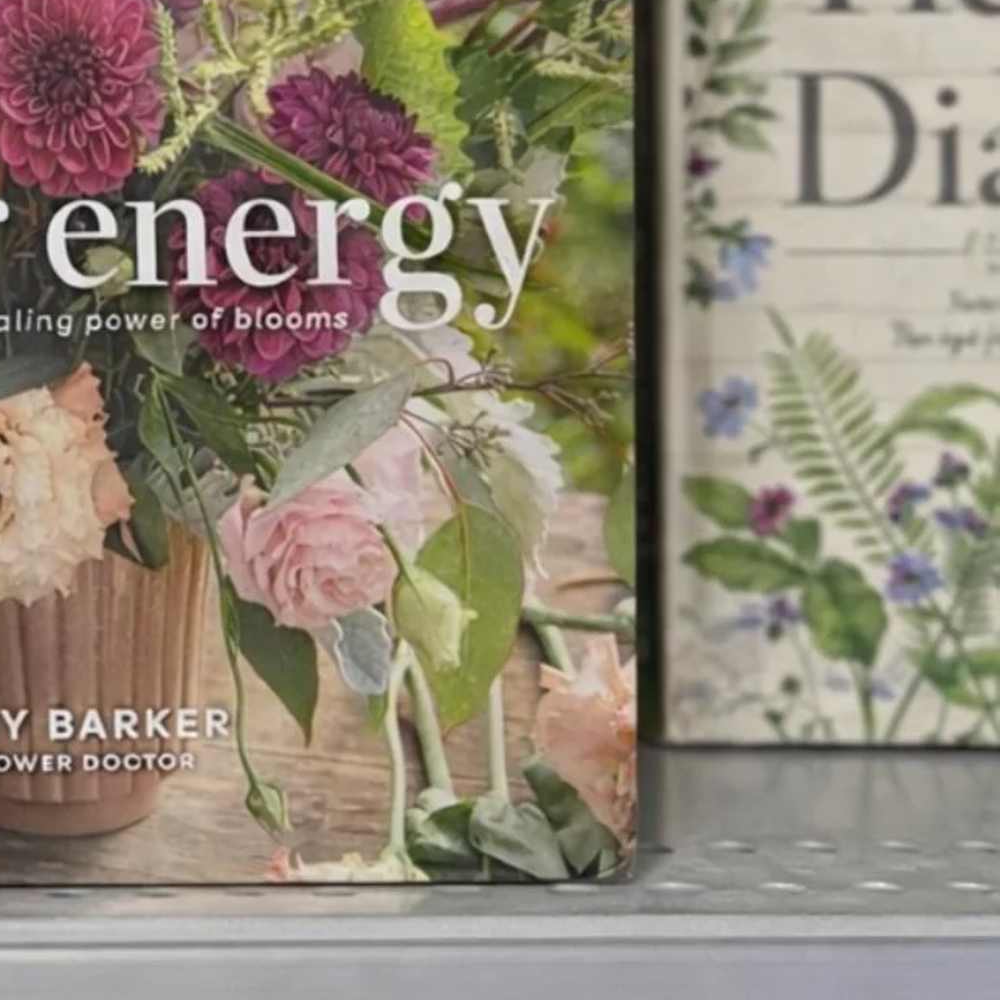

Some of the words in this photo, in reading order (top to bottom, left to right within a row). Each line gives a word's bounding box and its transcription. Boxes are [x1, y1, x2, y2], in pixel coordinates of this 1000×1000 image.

[45, 180, 553, 331] energy
[85, 311, 181, 336] power
[191, 307, 225, 331] of
[234, 307, 349, 330] blooms
[48, 707, 230, 740] BARKER
[83, 753, 196, 772] DOCTOR
